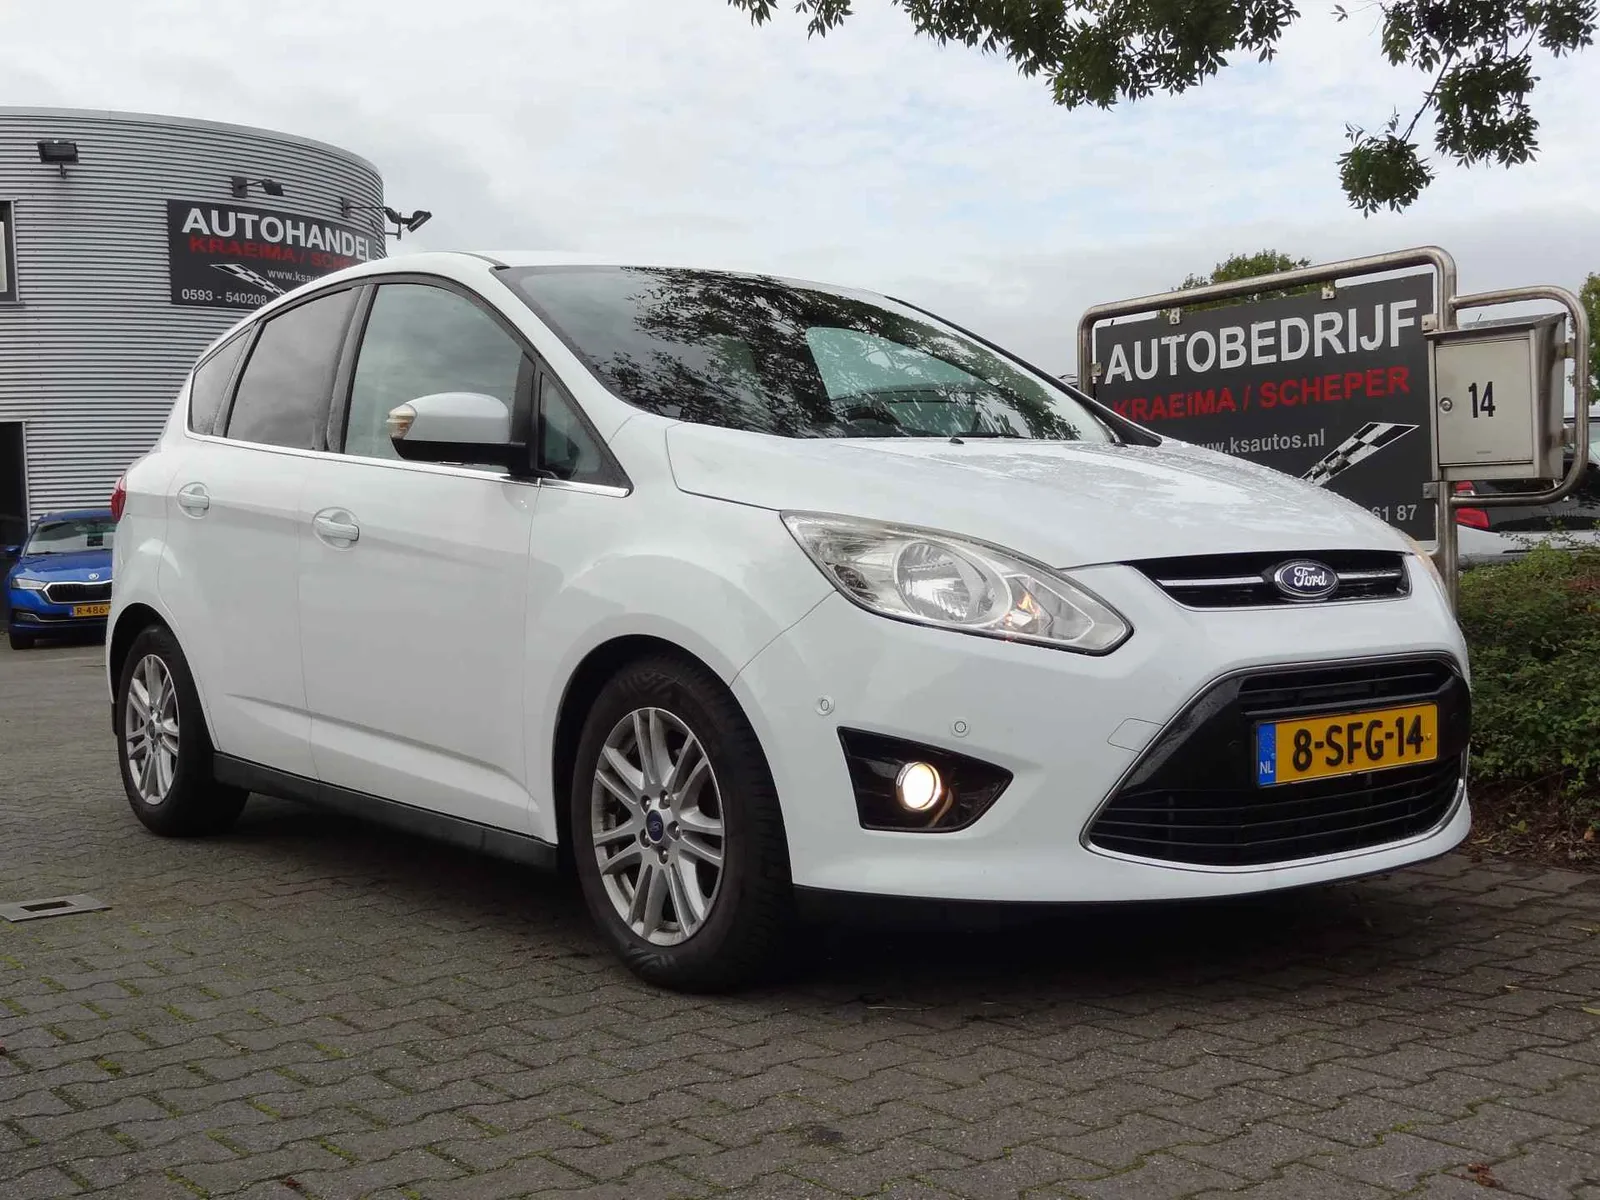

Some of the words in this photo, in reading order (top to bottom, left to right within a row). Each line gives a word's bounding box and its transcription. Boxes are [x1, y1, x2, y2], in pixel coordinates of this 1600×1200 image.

[182, 207, 370, 263] AUTOHANDEL
[181, 288, 213, 301] 0593
[225, 293, 268, 305] 540208
[1104, 299, 1417, 385] AUTOBEDRIJF
[1258, 366, 1410, 409] SCHEPER
[1468, 381, 1495, 418] 14
[1396, 504, 1417, 521] 87
[1294, 566, 1327, 587] Ford
[1292, 714, 1424, 773] 8-SFG-14
[1260, 760, 1274, 774] NL
